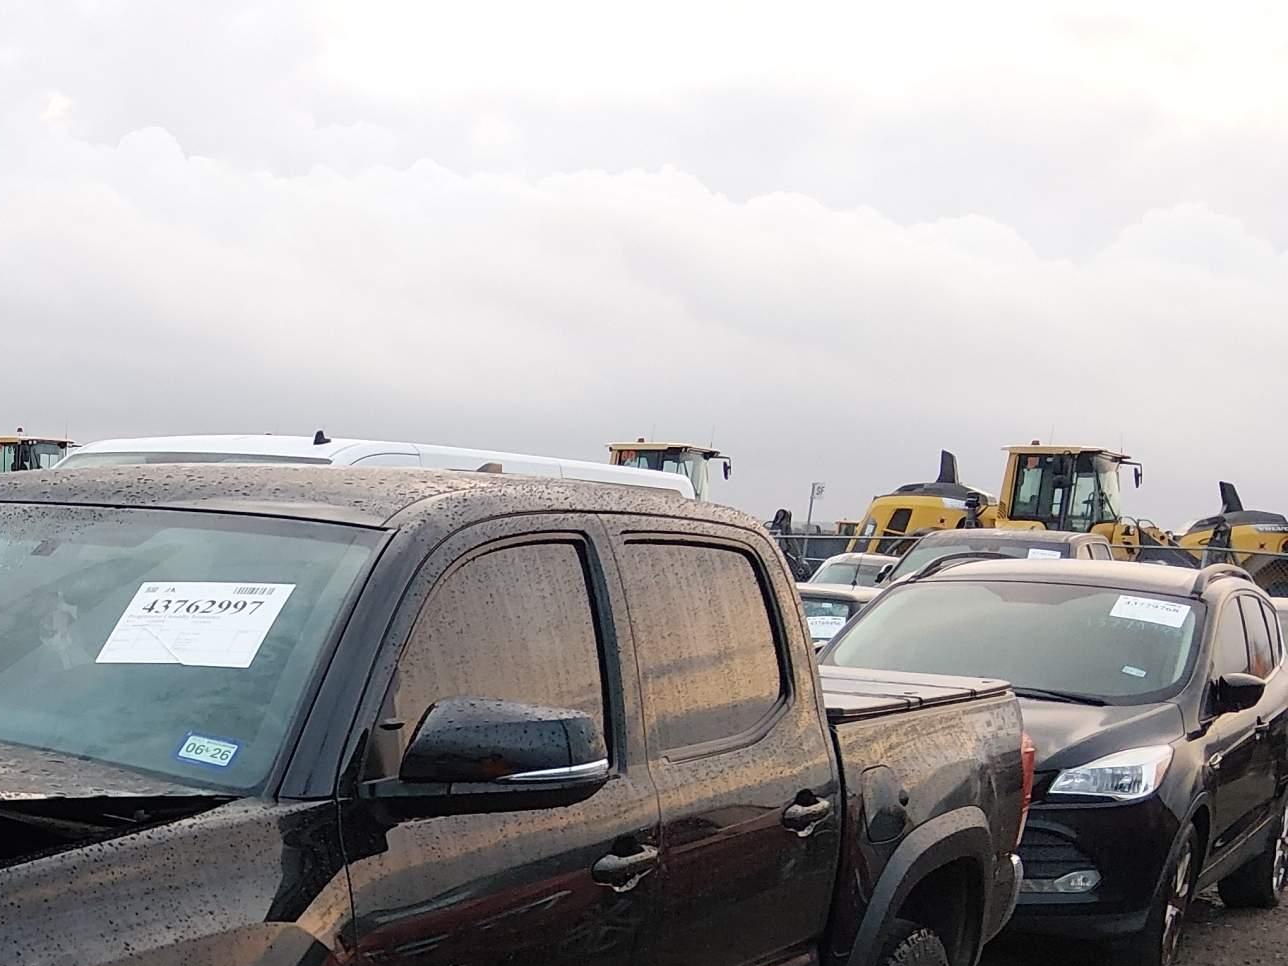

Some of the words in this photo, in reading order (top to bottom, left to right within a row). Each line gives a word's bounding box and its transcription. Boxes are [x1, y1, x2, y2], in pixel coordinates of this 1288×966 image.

[142, 599, 265, 616] 43762997
[185, 742, 206, 755] 06
[209, 747, 232, 761] 26
